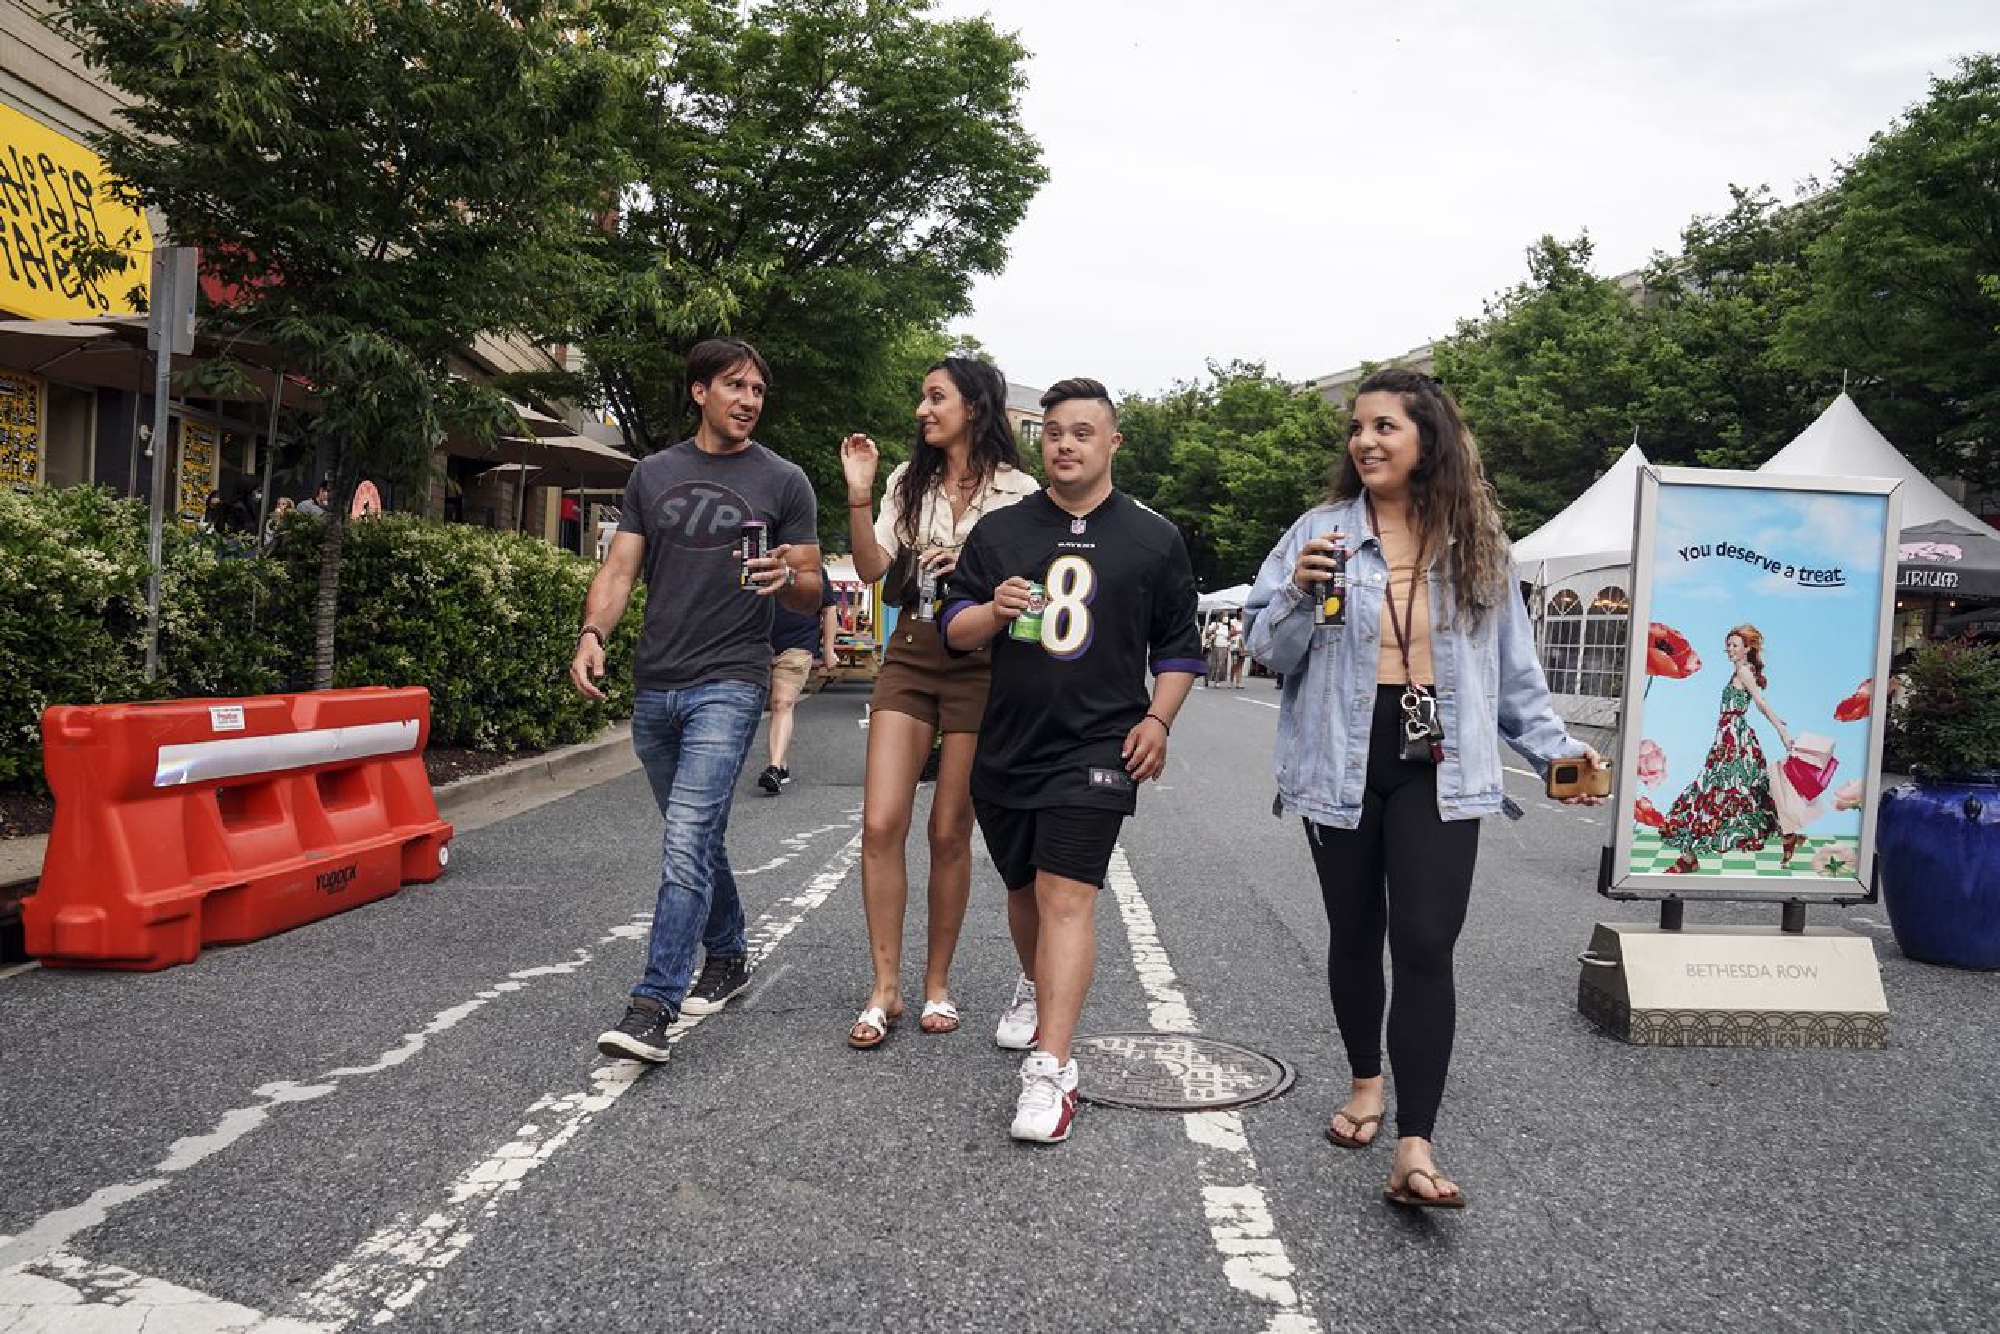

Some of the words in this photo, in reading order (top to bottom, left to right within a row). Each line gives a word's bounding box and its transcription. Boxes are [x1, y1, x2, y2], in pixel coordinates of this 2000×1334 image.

[658, 488, 741, 537] STP
[1678, 544, 1711, 562] You
[1716, 541, 1781, 574] deserve
[1784, 565, 1795, 578] a
[1799, 566, 1846, 583] treat.
[1042, 555, 1098, 660] 8
[1686, 963, 1773, 979] BETHESDA
[1776, 964, 1819, 979] ROW
